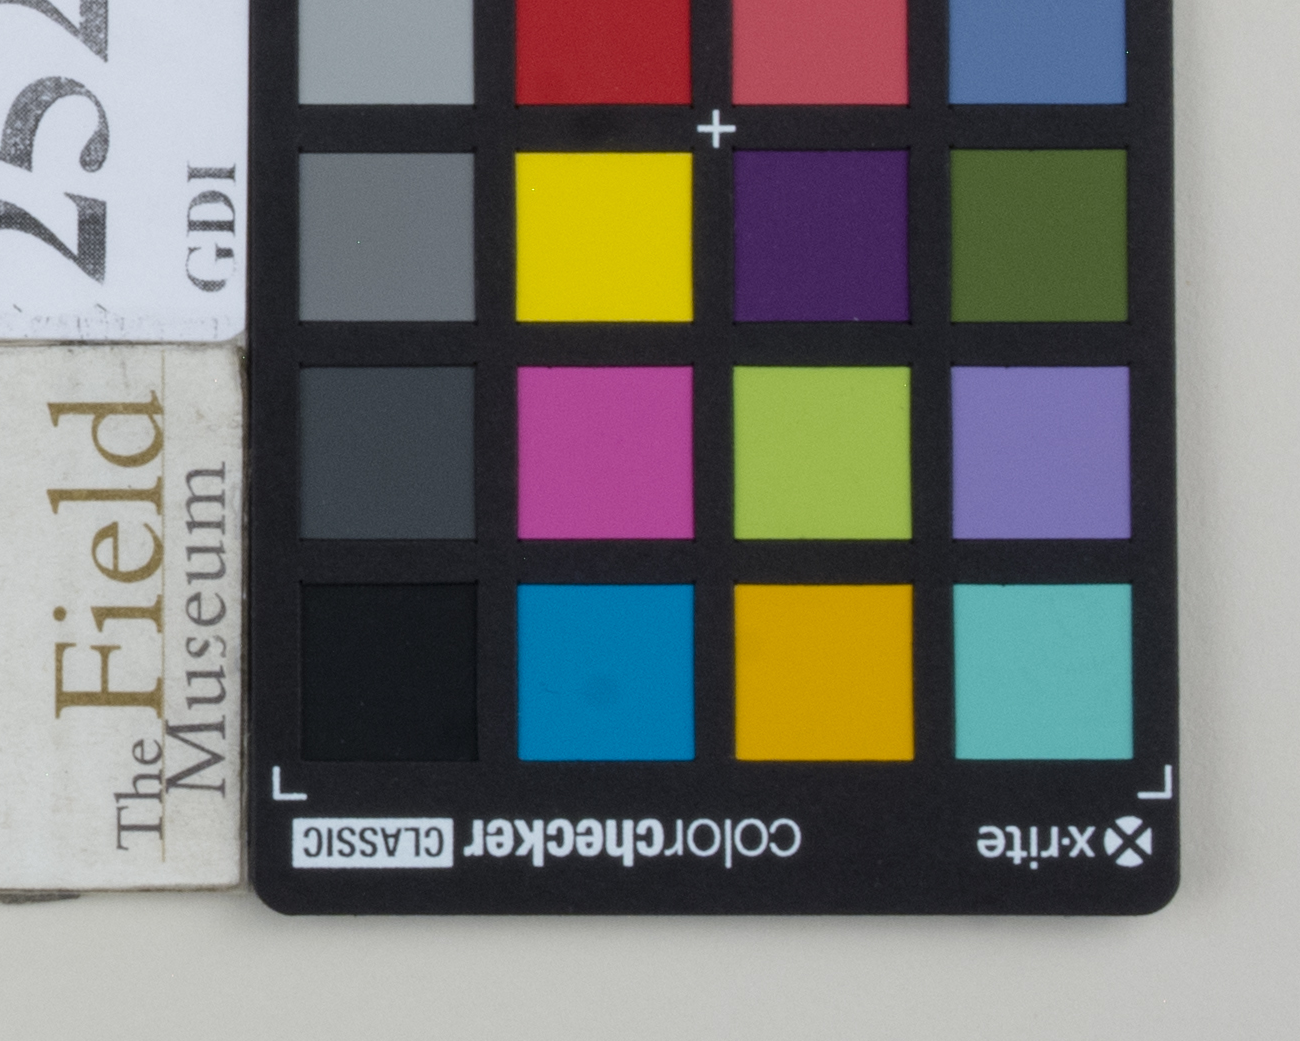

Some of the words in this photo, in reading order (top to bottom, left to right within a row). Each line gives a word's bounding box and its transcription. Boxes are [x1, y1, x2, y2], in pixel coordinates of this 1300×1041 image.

[185, 163, 237, 293] GDI
[45, 389, 165, 720] Field
[165, 461, 227, 798] Museum
[115, 737, 164, 851] The
[303, 826, 445, 859] CLASSIC
[463, 818, 802, 869] colorchecker
